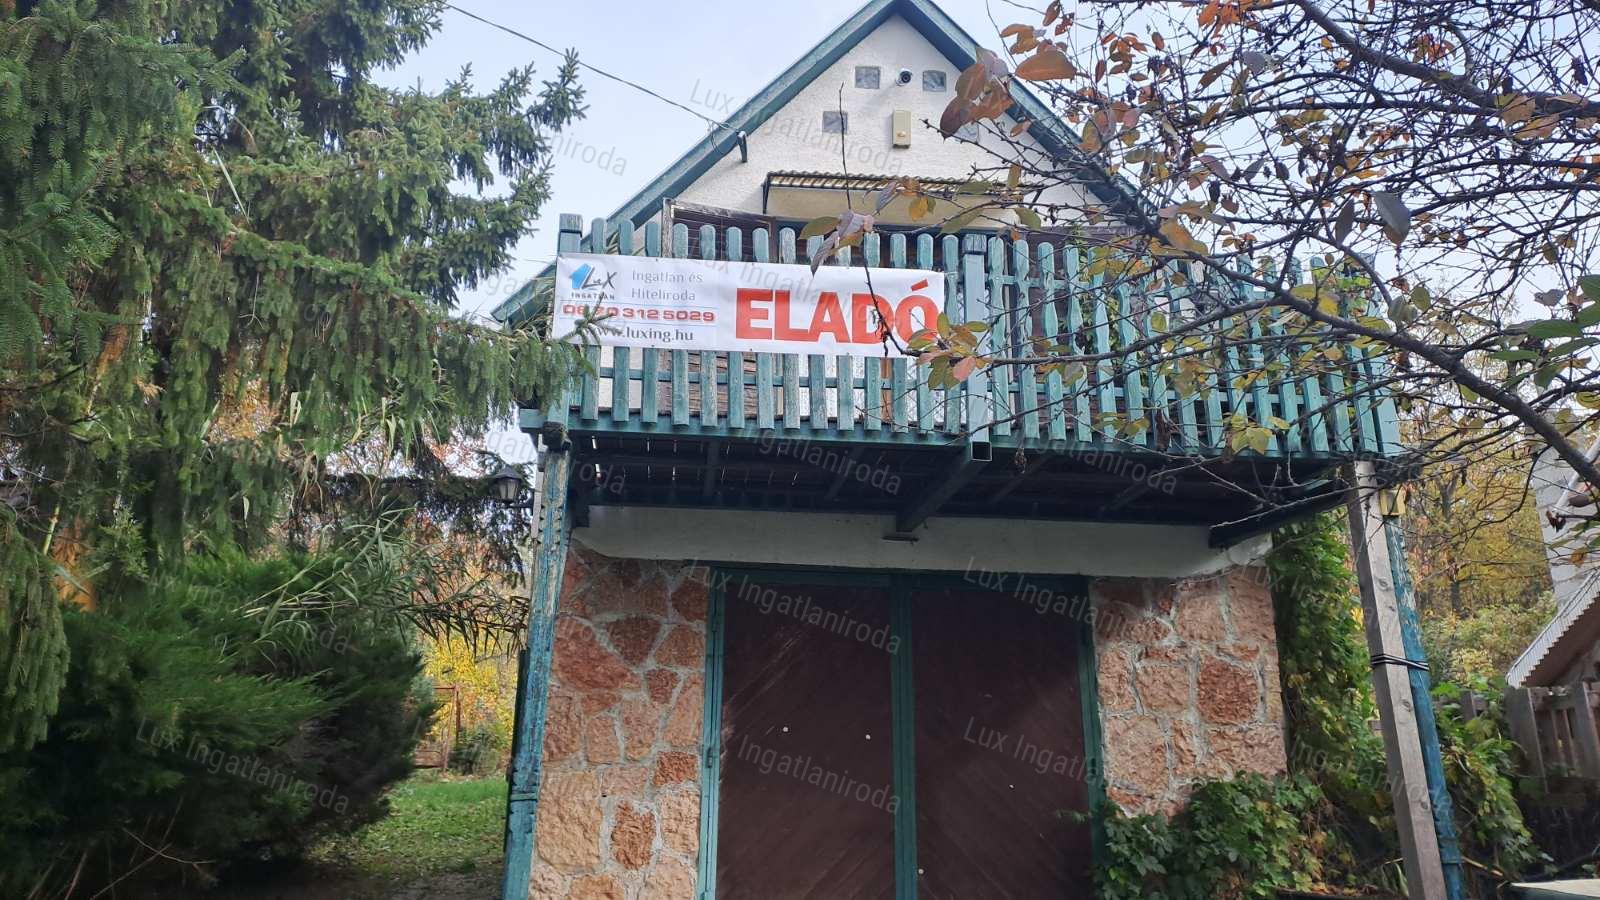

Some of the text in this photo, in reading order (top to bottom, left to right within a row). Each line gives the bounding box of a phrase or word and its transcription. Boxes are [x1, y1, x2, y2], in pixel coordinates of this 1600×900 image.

[631, 269, 703, 284] Ingatlan és
[630, 287, 697, 302] Hiteliroda
[735, 278, 940, 346] ELADÓ
